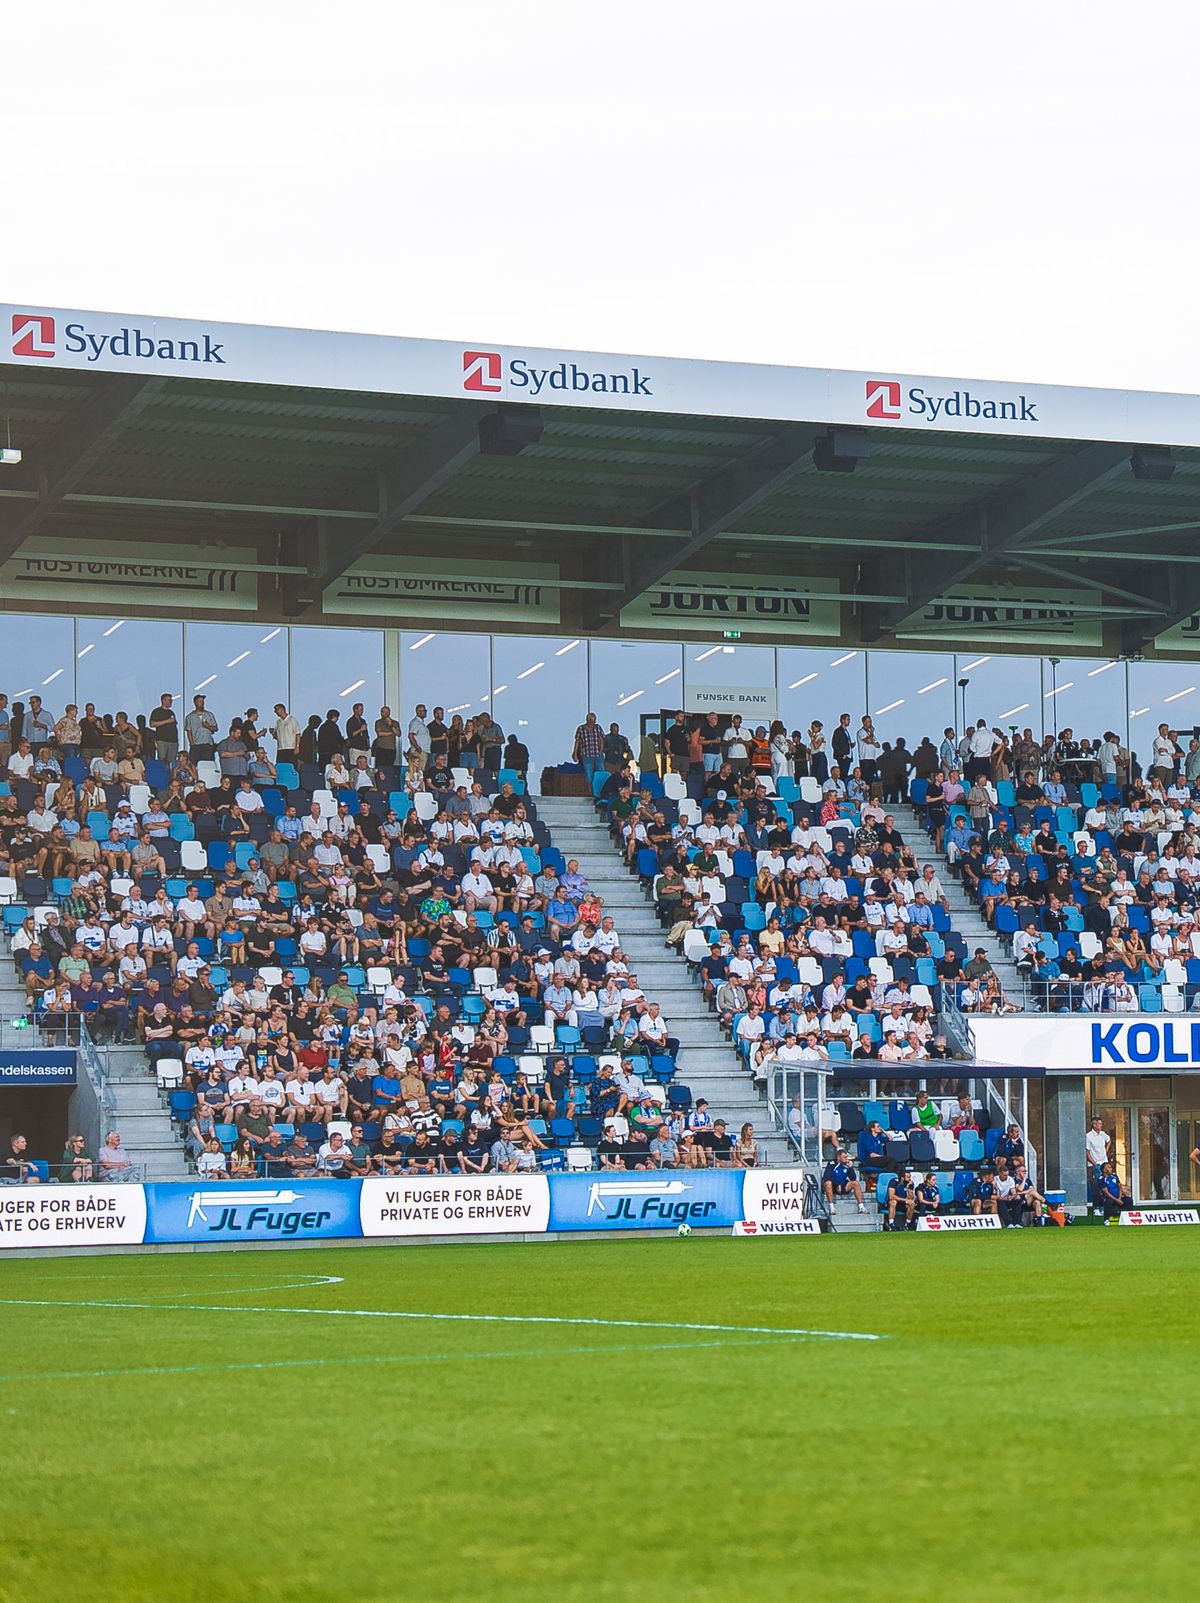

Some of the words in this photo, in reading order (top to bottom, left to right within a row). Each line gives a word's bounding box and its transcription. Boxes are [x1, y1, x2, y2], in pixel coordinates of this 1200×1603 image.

[65, 323, 226, 364] Sydbank
[509, 359, 653, 396] Sydbank
[908, 388, 1039, 422] Sydbank
[650, 582, 810, 615] JORTON
[738, 694, 767, 703] BANK
[386, 1191, 399, 1204] VI
[404, 1190, 450, 1203] FUGER
[454, 1189, 481, 1202] FOR
[486, 1185, 523, 1201] BÅDE
[766, 1182, 778, 1194] VI
[40, 1199, 70, 1213] FOR
[76, 1195, 117, 1212] BÅDE
[380, 1207, 439, 1221] PRIVATE
[443, 1206, 464, 1219] OG
[468, 1204, 531, 1218] ERHVERV
[607, 1198, 636, 1219] JL
[640, 1197, 716, 1222] Fuger
[27, 1218, 50, 1231] OG
[55, 1215, 126, 1230] ERHVERV
[209, 1208, 242, 1231] JL
[245, 1207, 331, 1234] Fuger
